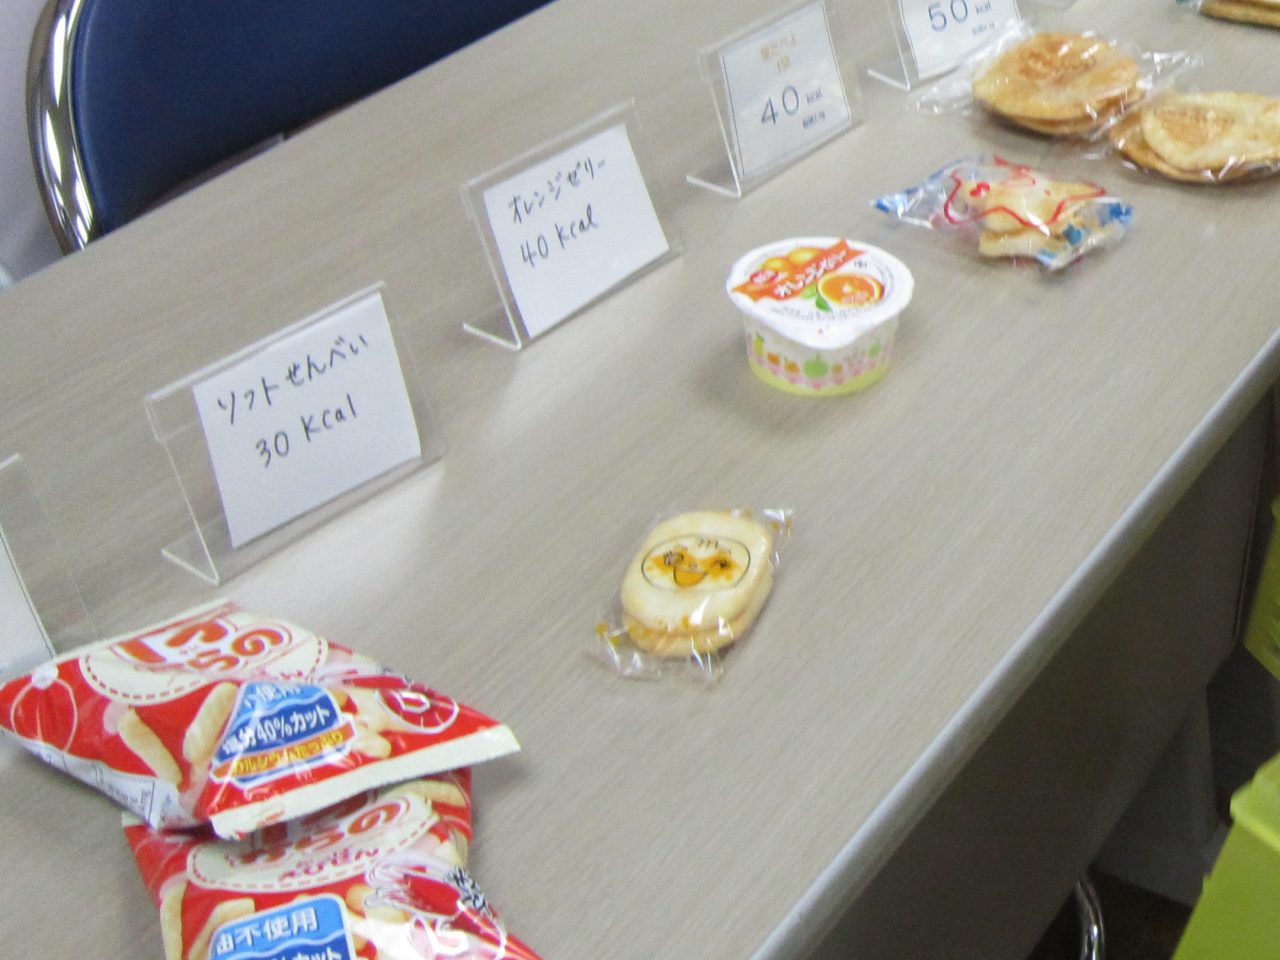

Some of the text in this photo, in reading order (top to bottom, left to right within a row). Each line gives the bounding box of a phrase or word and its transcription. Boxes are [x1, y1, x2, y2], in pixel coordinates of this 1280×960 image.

[761, 85, 800, 125] 40
[520, 234, 549, 268] 40
[255, 430, 290, 468] 30
